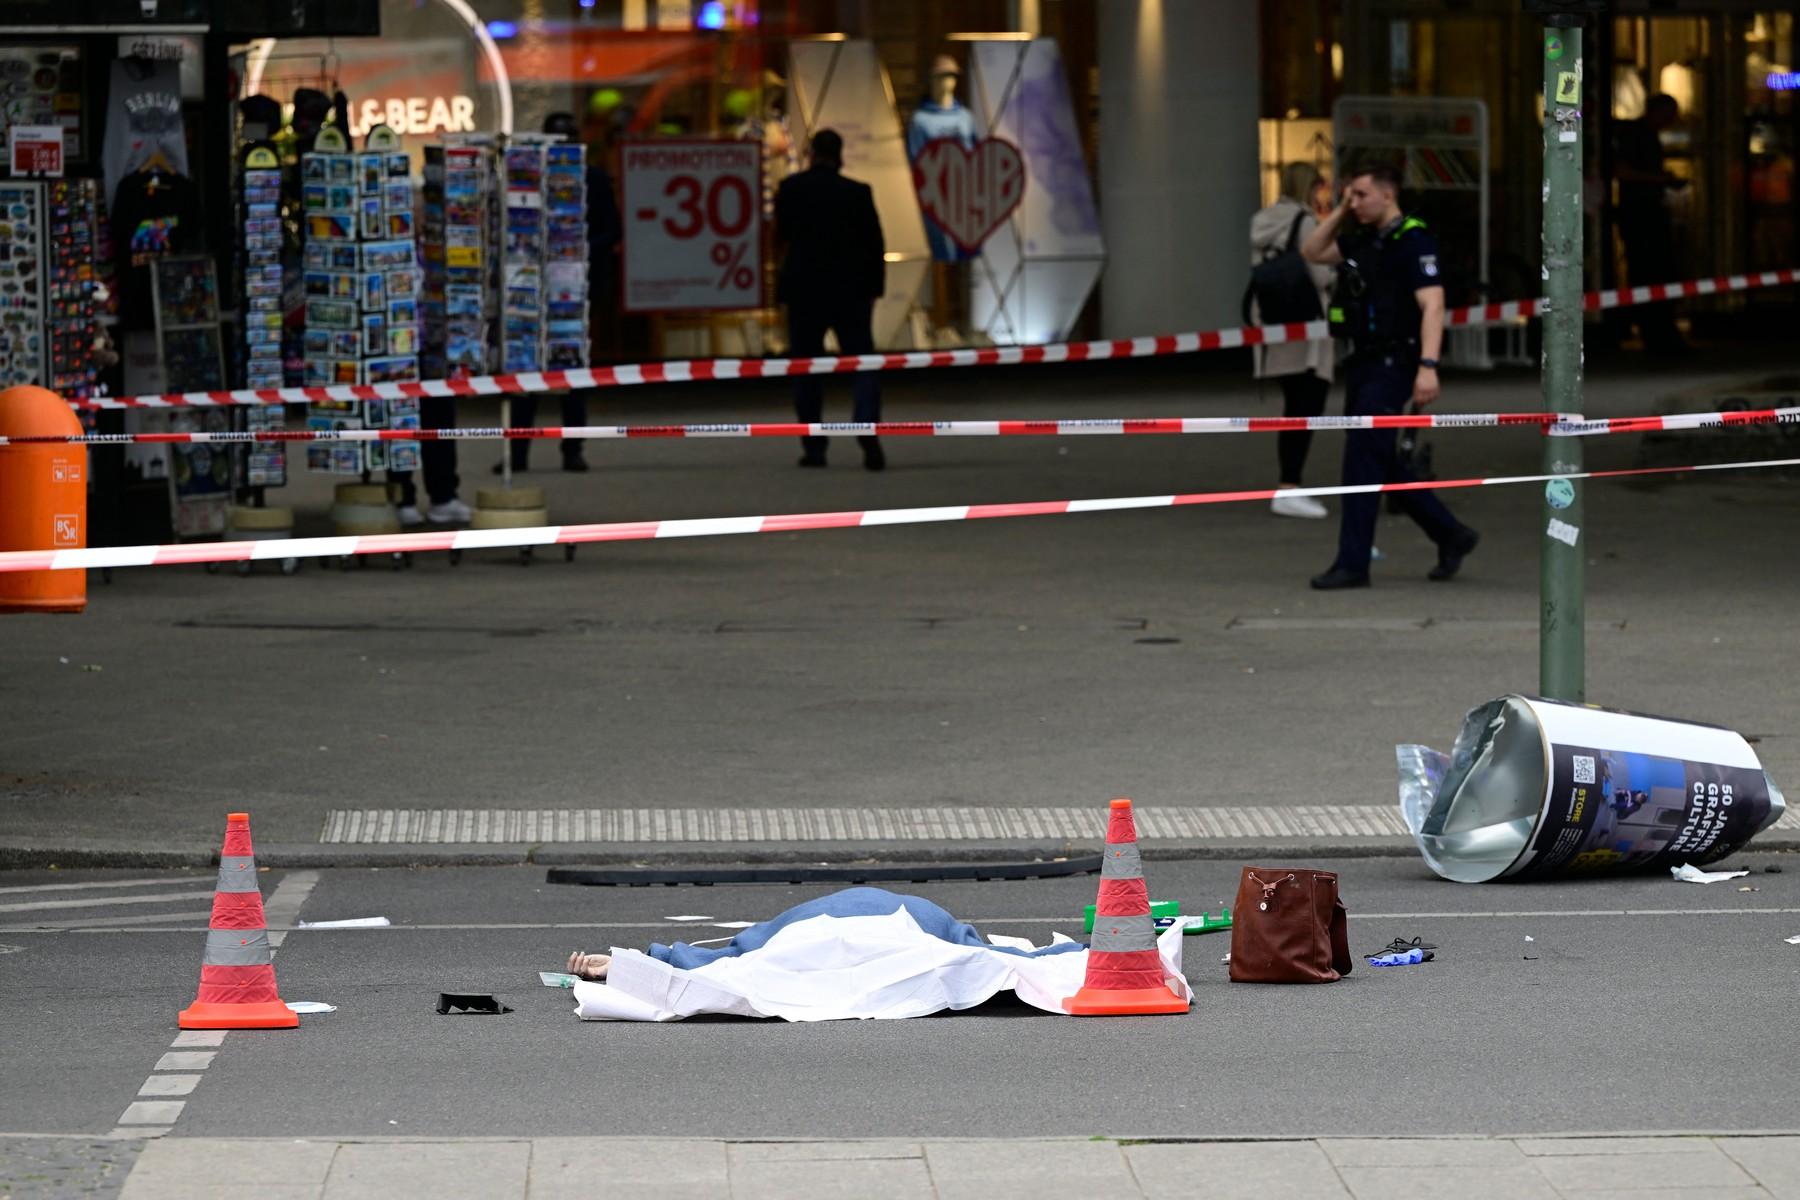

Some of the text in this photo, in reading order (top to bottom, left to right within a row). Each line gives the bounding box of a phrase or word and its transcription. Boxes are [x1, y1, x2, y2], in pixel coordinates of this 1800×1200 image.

[126, 92, 179, 112] BERLIN
[326, 95, 476, 137] L&BEAR
[628, 150, 752, 170] PROMOTION
[636, 174, 754, 240] -30
[710, 241, 755, 291] %
[56, 519, 77, 540] BSR
[1571, 788, 1587, 824] STORE
[1668, 781, 1705, 852] CULTURE
[1681, 782, 1719, 853] GRAFFITI
[1694, 783, 1733, 853] 50 JAHRE
